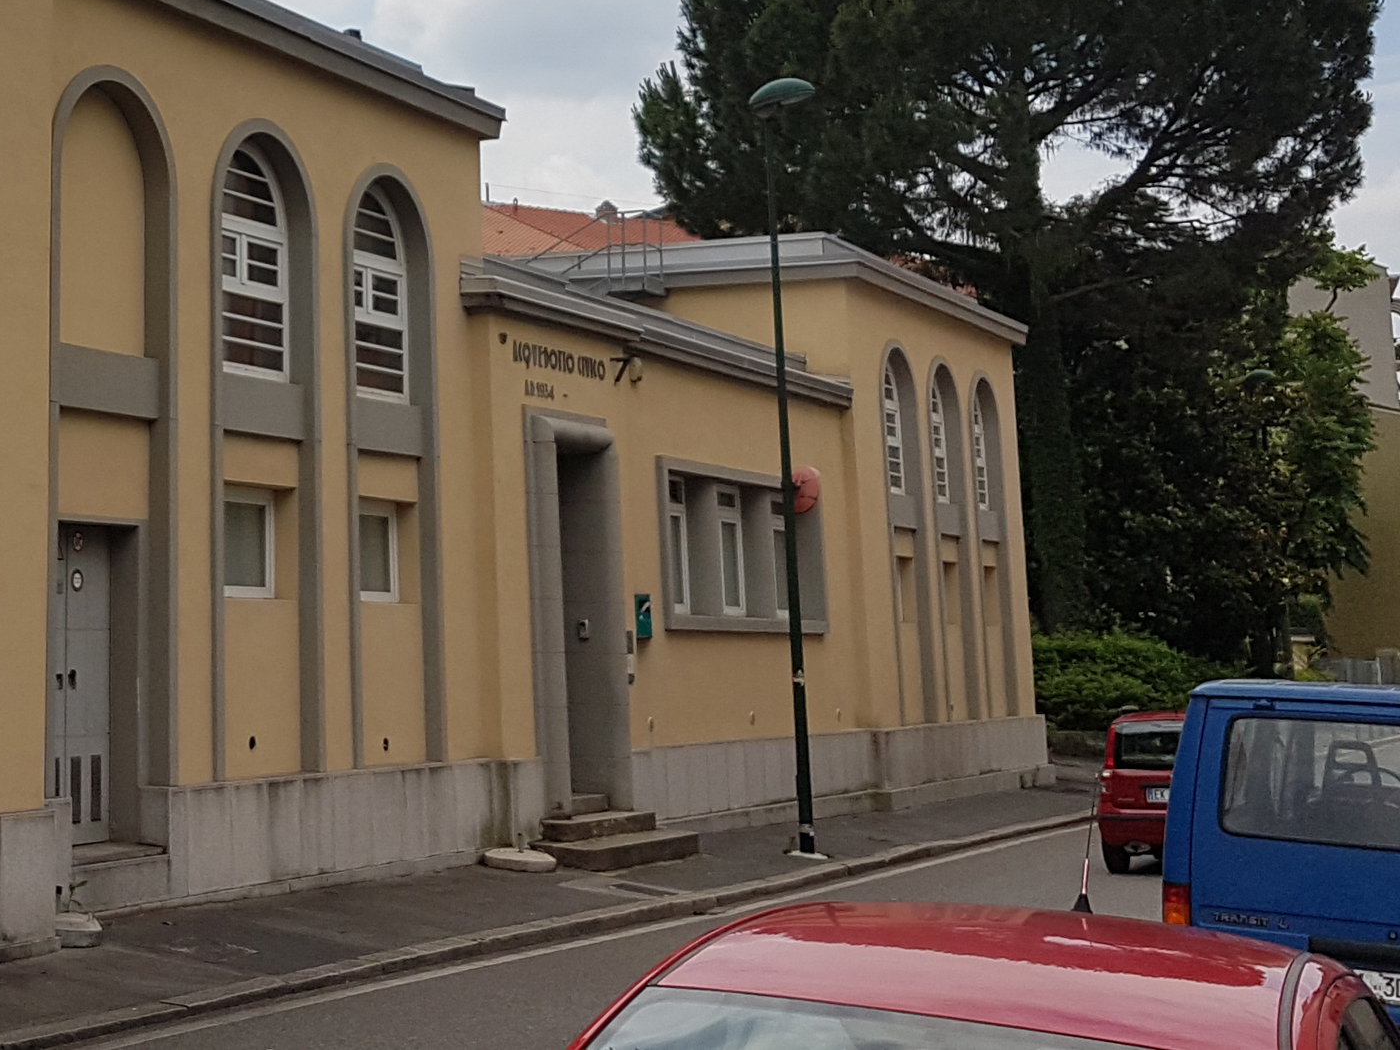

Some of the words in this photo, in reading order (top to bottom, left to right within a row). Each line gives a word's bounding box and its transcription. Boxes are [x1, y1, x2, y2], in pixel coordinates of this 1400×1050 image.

[577, 355, 606, 381] CIVICO
[536, 381, 555, 401] 1934
[1213, 912, 1269, 928] TRANSIT
